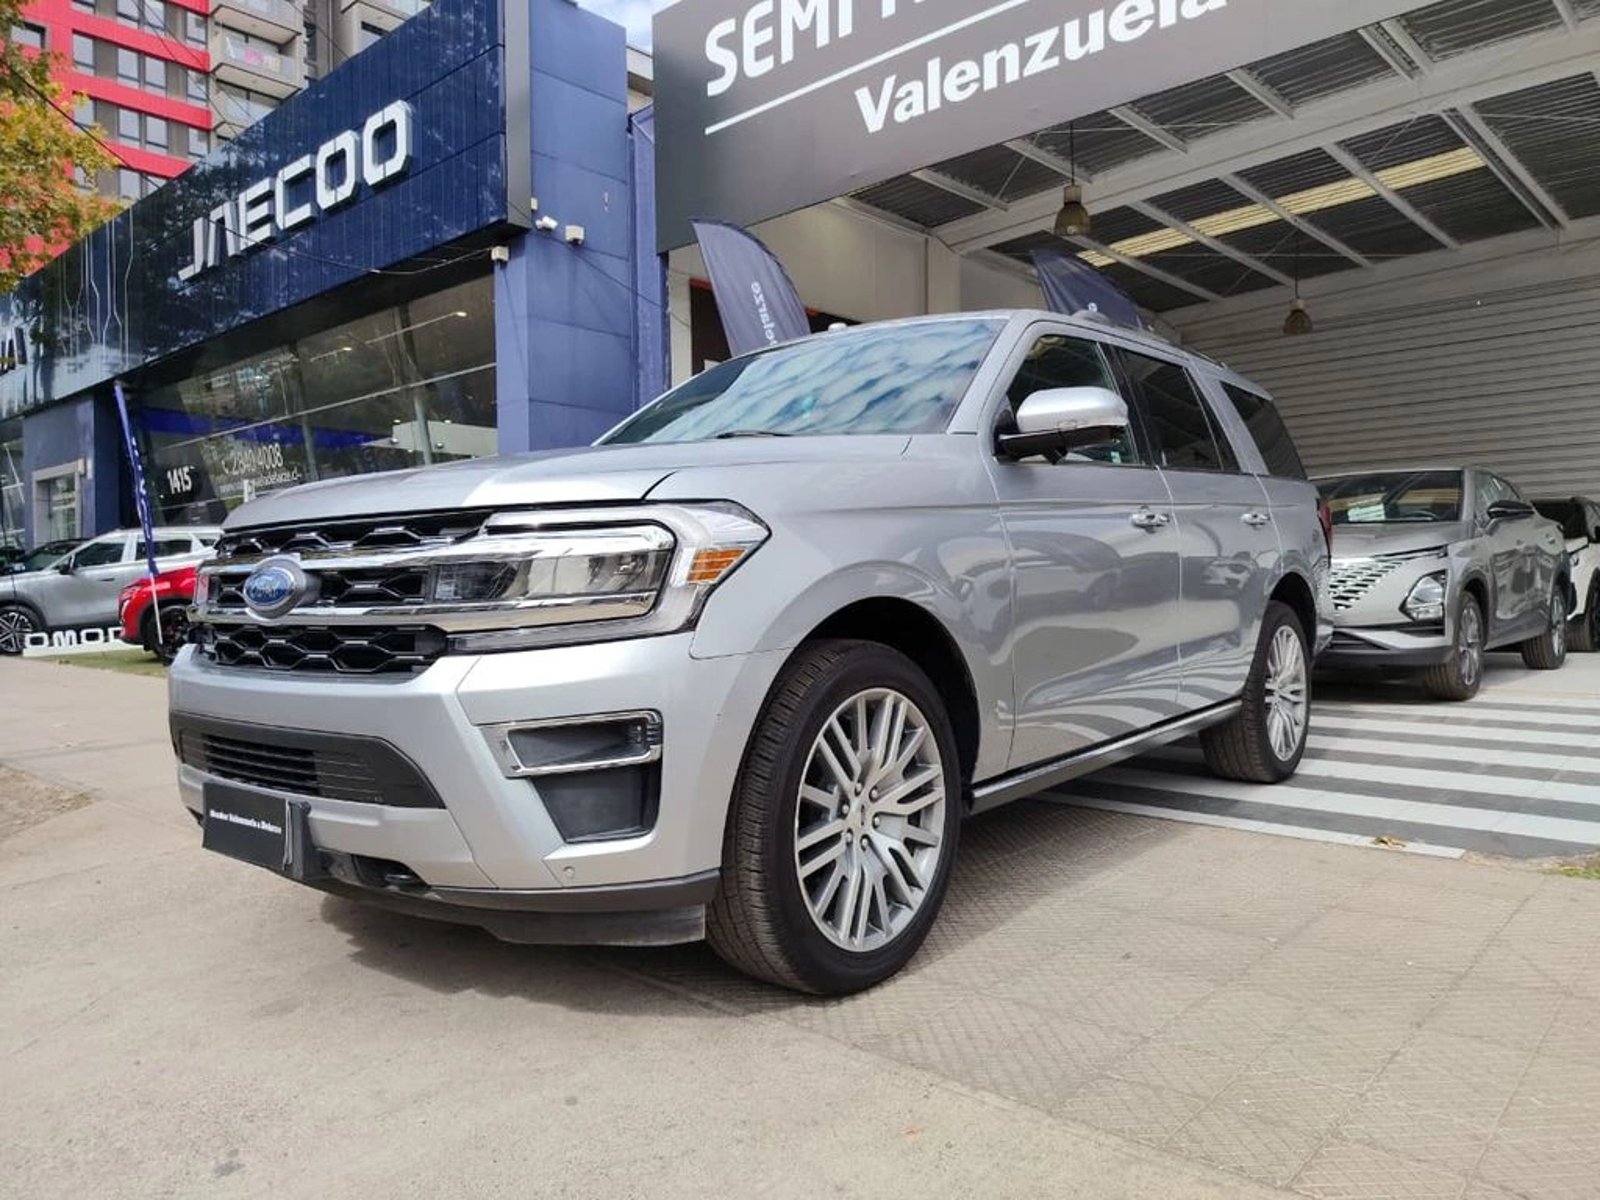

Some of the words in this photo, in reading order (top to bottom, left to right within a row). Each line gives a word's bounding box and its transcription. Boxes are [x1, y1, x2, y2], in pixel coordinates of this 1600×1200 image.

[705, 0, 853, 97] SEMI
[167, 466, 192, 495] 1415
[24, 627, 124, 649] OMOD
